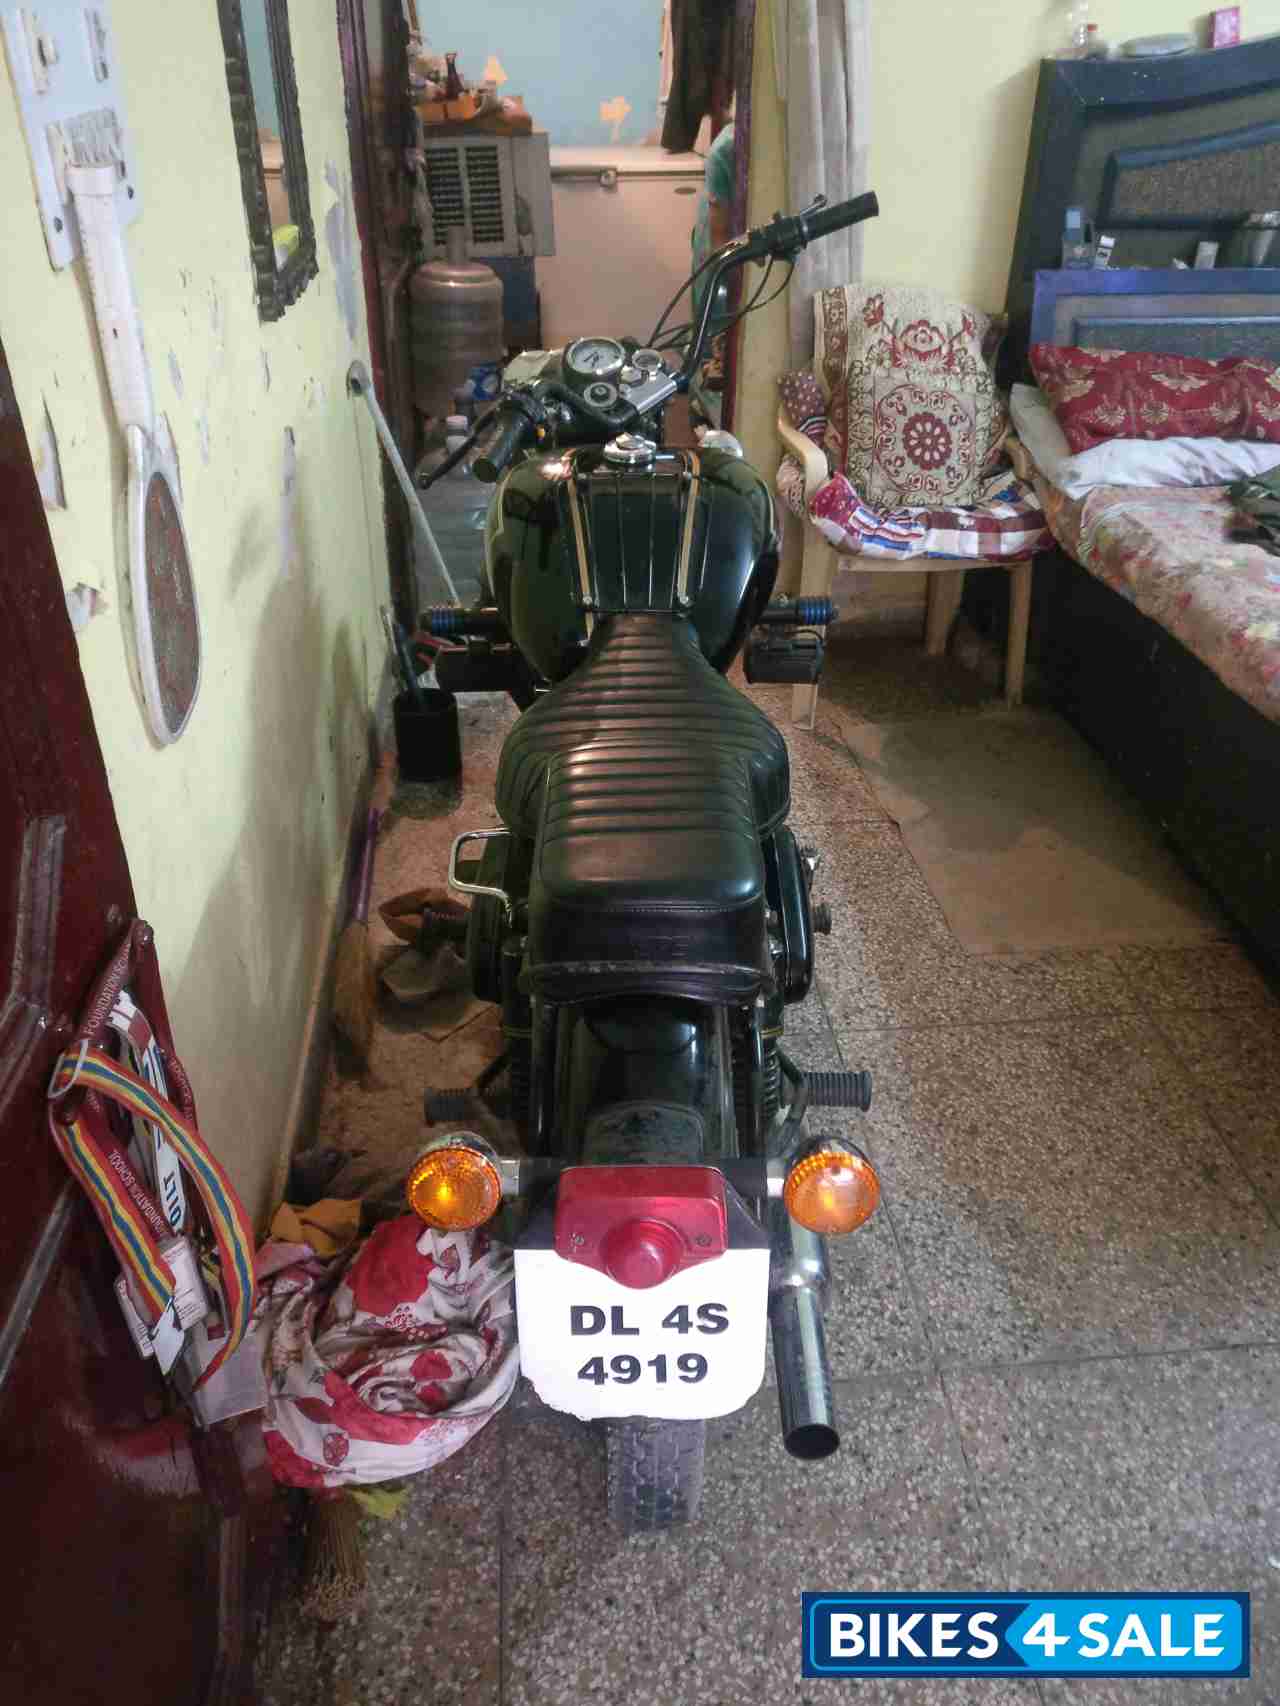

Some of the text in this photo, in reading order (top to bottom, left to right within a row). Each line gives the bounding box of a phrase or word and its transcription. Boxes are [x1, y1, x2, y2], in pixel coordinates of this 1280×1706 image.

[570, 1302, 729, 1336] DL 4S
[577, 1353, 708, 1386] 4919
